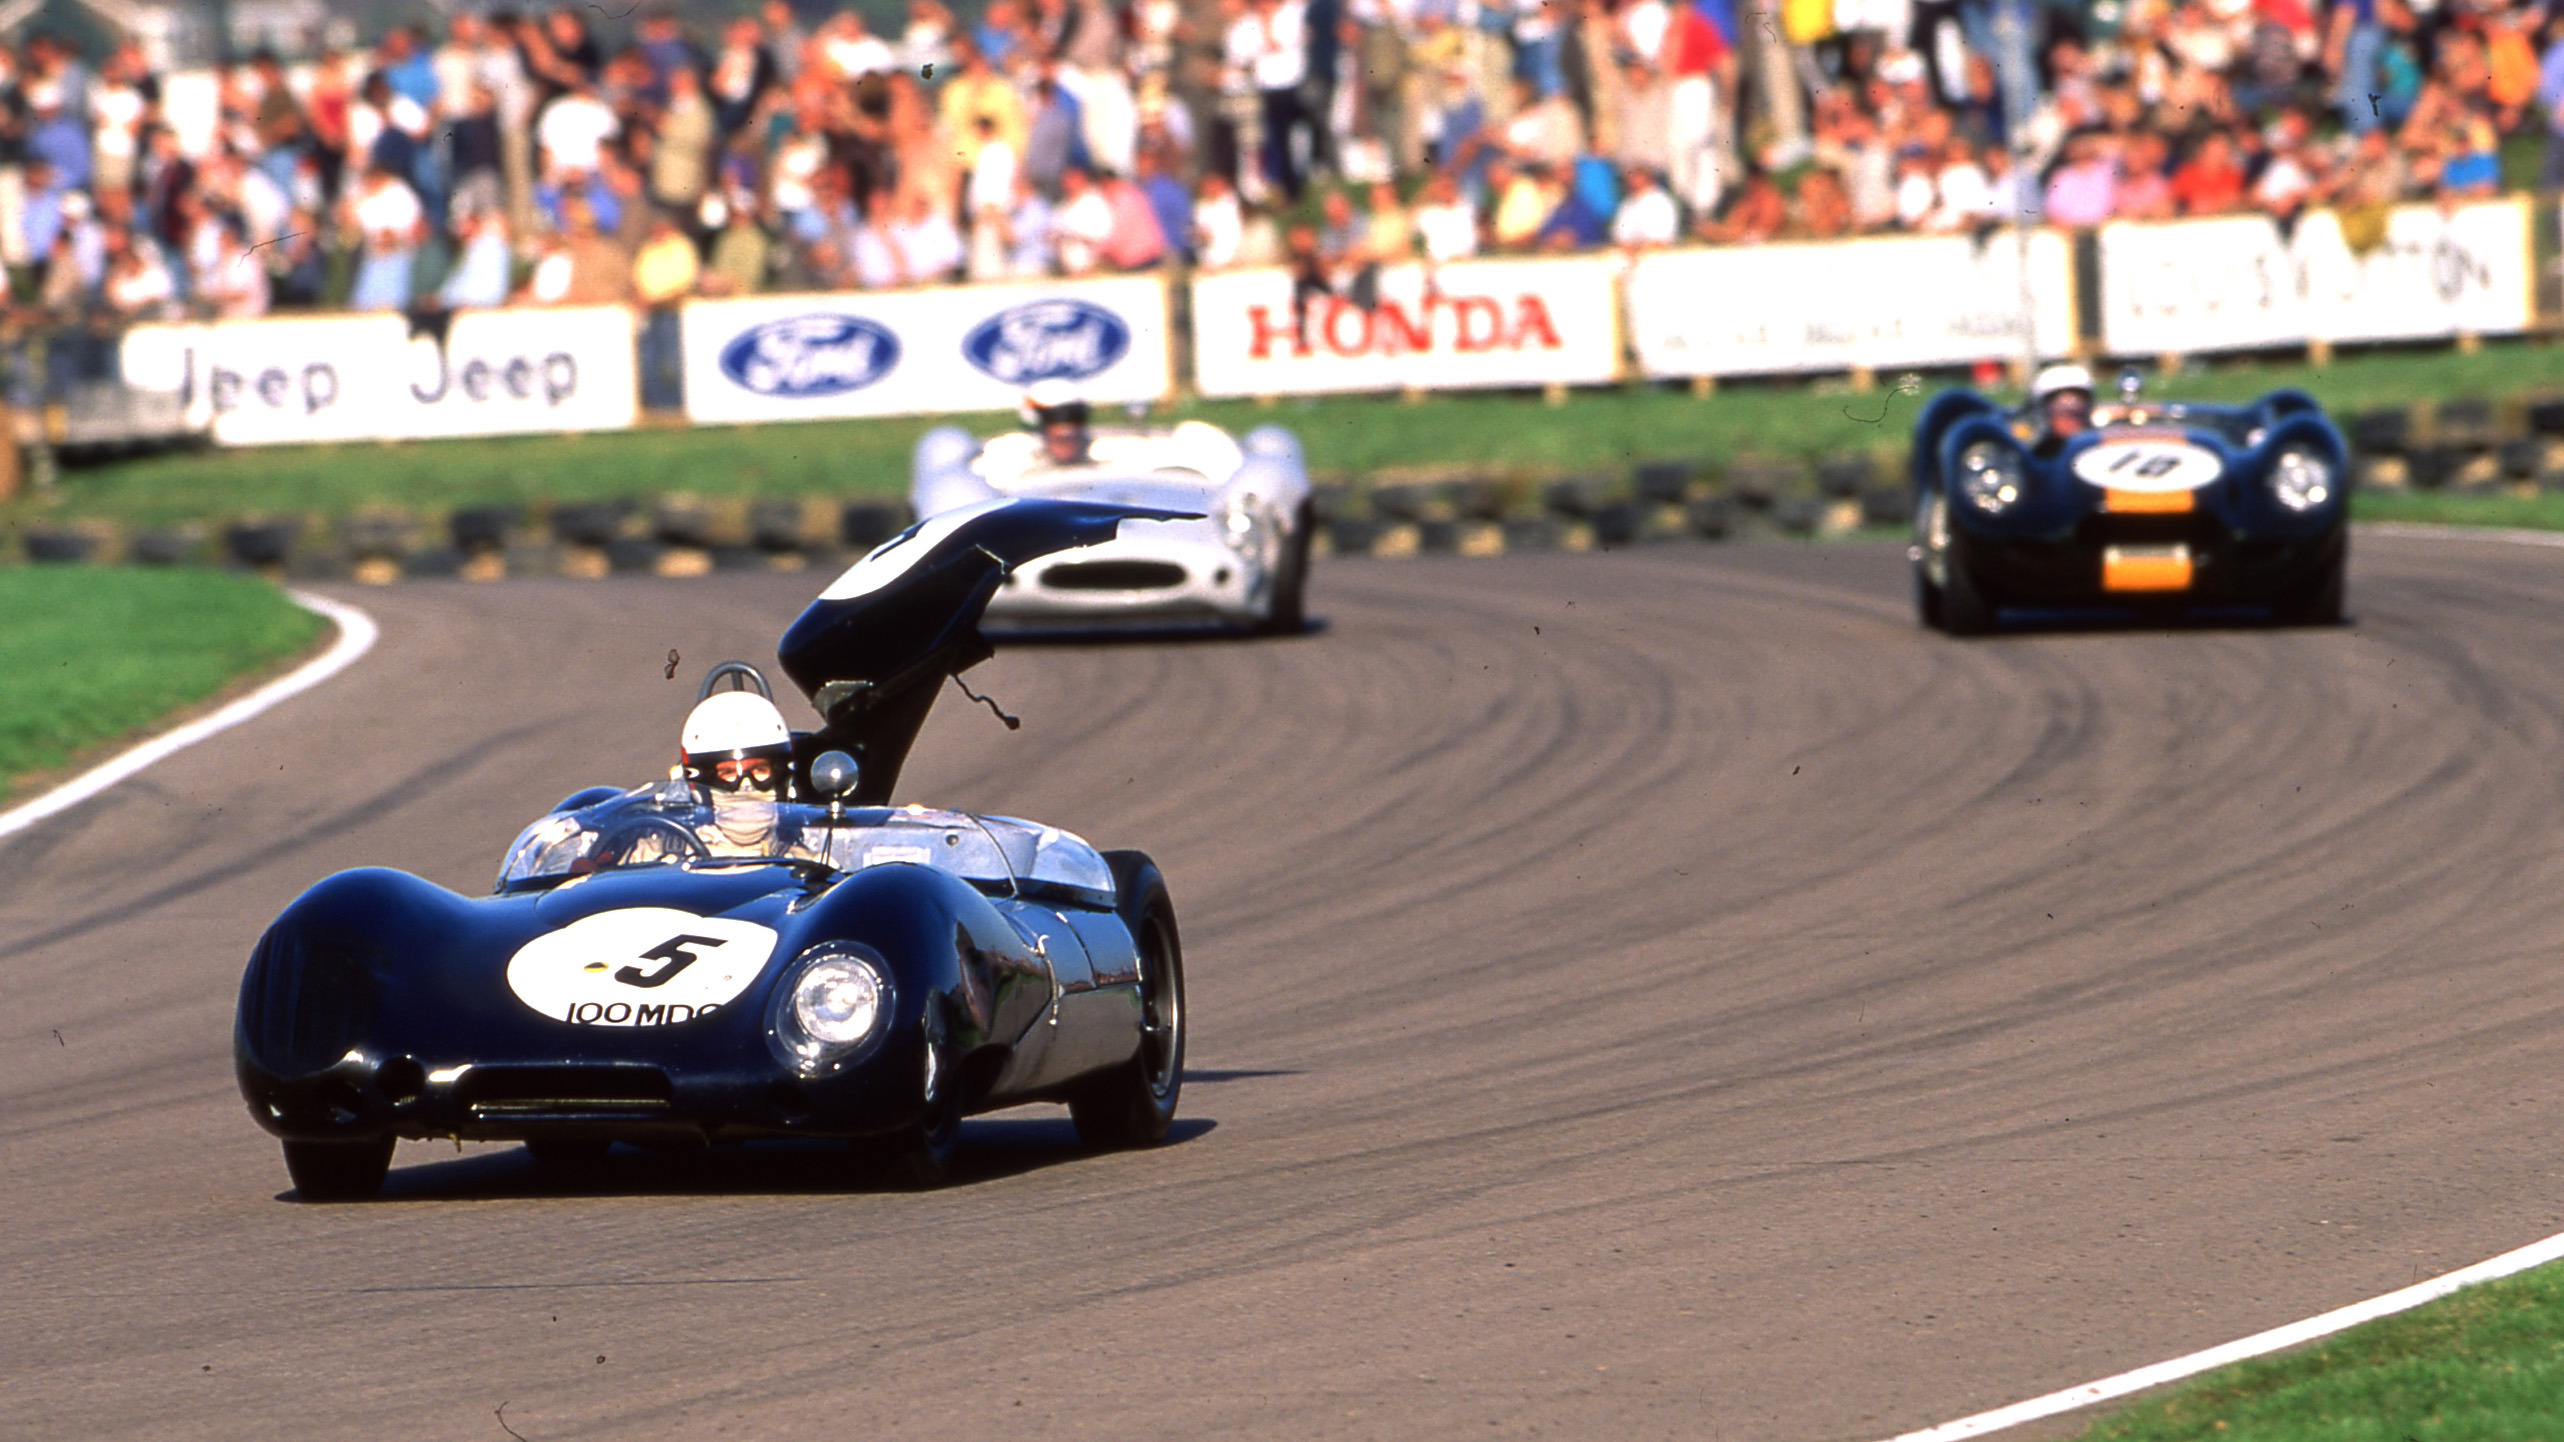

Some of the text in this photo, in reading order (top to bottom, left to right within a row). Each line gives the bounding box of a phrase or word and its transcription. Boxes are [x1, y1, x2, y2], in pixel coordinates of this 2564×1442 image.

[742, 318, 880, 392] Ford
[985, 302, 1107, 383] Ford
[1246, 293, 1564, 360] HONDA
[410, 350, 578, 406] Jeep
[613, 933, 729, 989] 5
